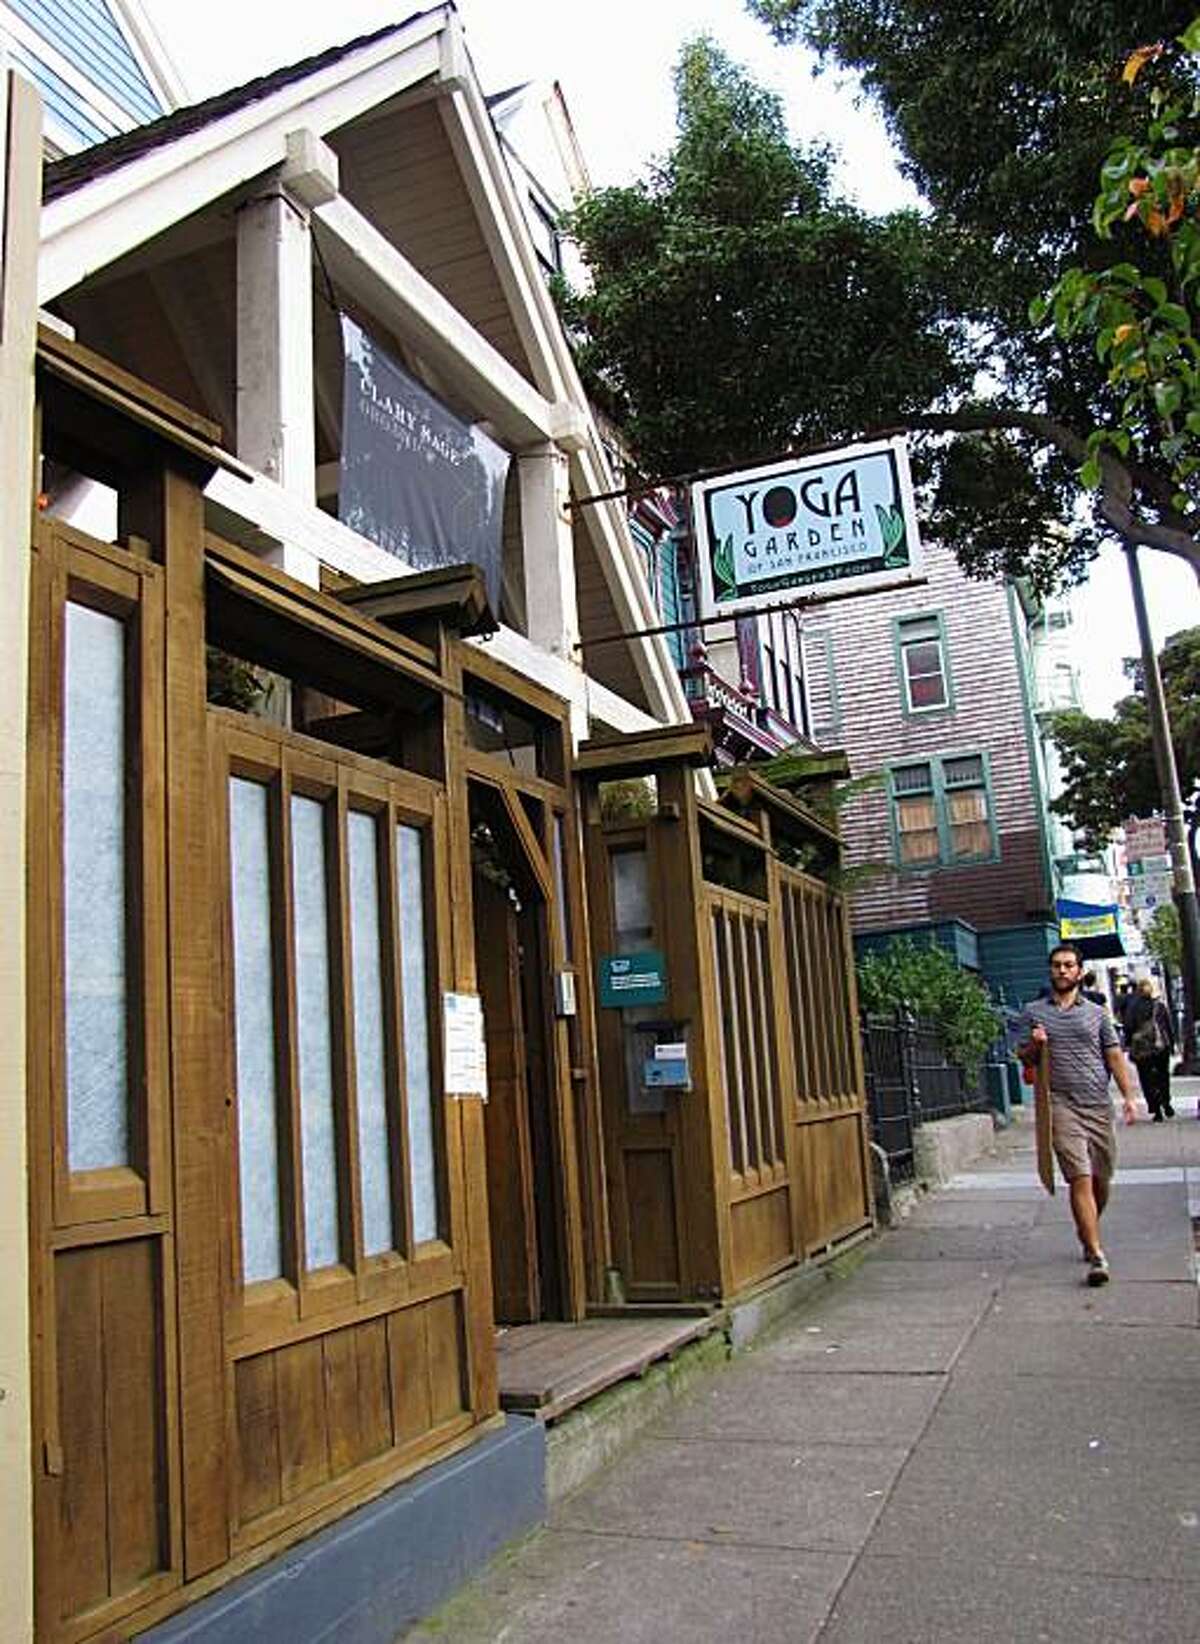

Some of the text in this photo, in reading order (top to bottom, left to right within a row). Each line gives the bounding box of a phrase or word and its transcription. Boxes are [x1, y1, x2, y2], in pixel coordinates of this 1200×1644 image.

[735, 469, 861, 534] YOGA
[744, 518, 865, 558] GARDEN
[769, 556, 793, 570] SAN
[798, 542, 868, 561] FRANCISCO
